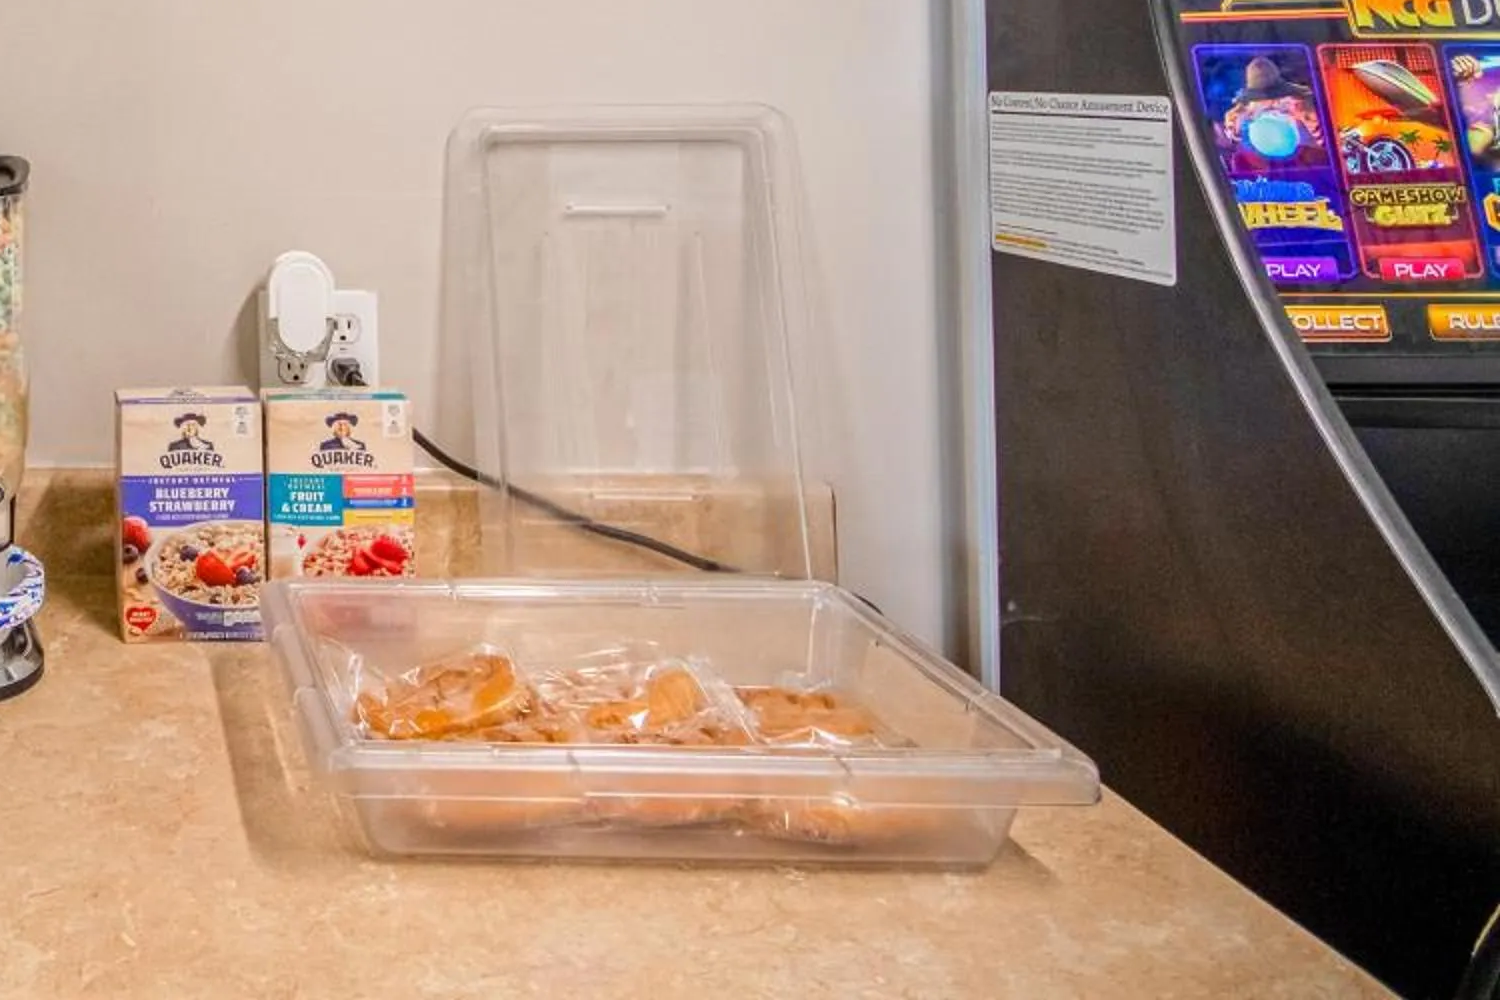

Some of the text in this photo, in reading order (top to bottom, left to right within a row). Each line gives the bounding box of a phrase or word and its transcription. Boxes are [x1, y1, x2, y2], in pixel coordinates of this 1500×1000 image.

[1136, 101, 1168, 114] Device
[1350, 186, 1466, 206] GAMESHOW
[1265, 263, 1321, 278] PLAY
[1393, 263, 1449, 278] PLAY
[159, 451, 223, 469] QUAKER
[311, 451, 374, 469] QUAKER
[155, 487, 230, 499] BLUEBERRY
[290, 491, 325, 502] FRUIT
[148, 500, 237, 513] STRAWBERRY
[281, 503, 333, 513] & CREAM
